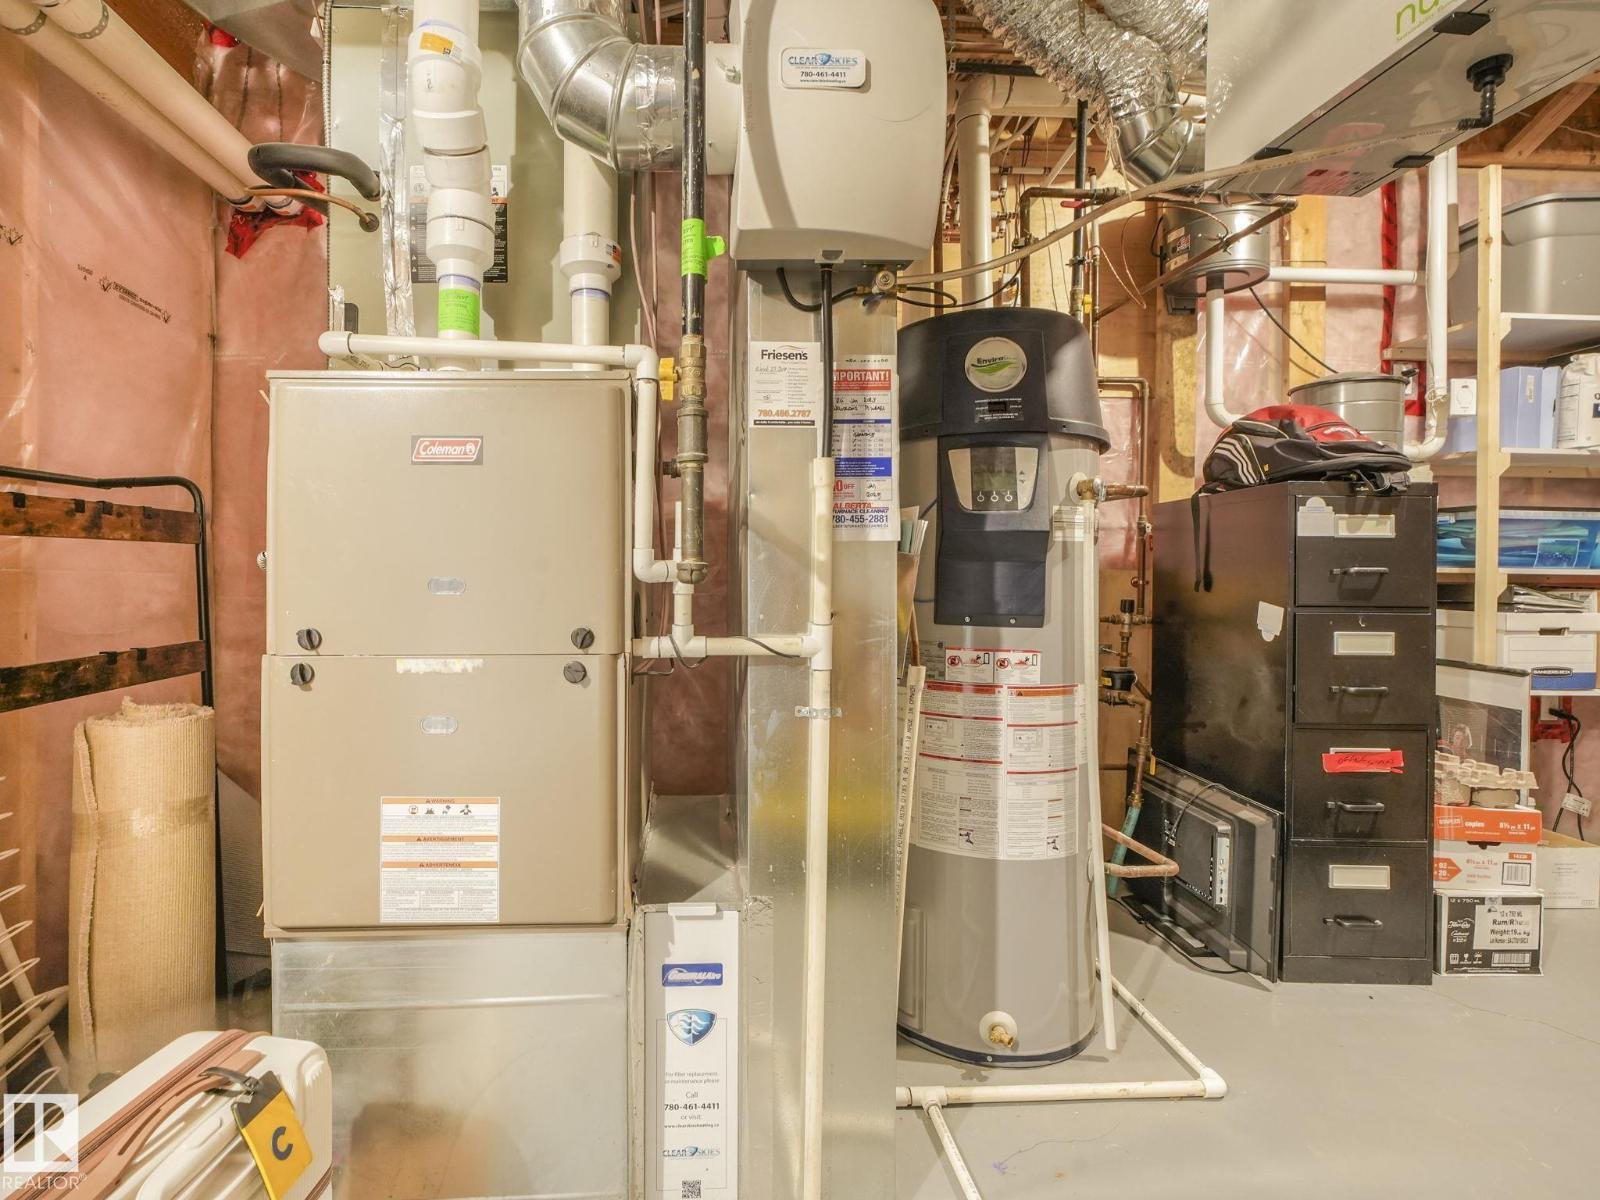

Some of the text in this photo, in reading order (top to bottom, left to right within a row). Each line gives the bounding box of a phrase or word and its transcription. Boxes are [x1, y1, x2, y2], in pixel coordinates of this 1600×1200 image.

[788, 56, 818, 65] CLEAR
[761, 349, 808, 360] Friesen's
[833, 371, 889, 381] MPORTANT!
[419, 441, 465, 455] Coleman
[685, 1091, 699, 1099] Call
[664, 1102, 720, 1111] 780-461-4411
[272, 1126, 294, 1161] C
[662, 1149, 687, 1157] CLEAR
